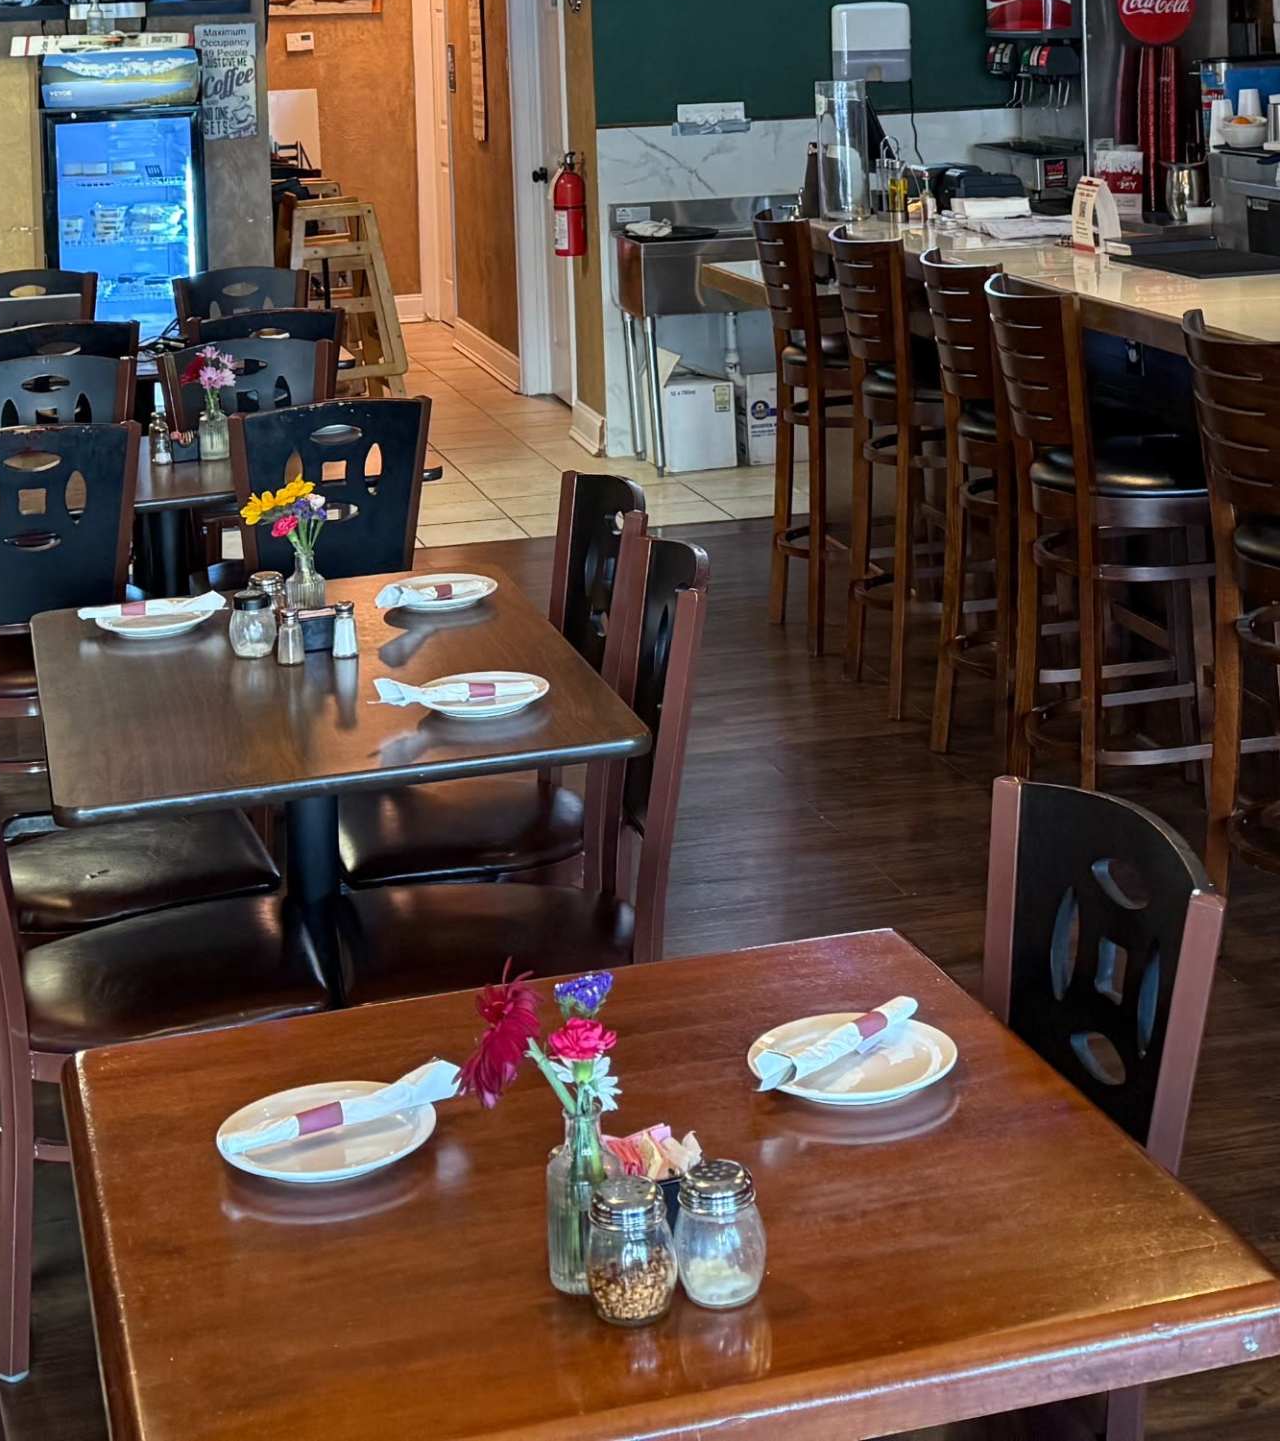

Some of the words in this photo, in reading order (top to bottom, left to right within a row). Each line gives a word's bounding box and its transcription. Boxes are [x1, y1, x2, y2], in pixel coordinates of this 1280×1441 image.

[202, 28, 247, 37] Maximum
[200, 38, 250, 48] Occupancy
[217, 48, 248, 57] People
[205, 58, 221, 68] JUST
[238, 57, 247, 67] ME
[204, 67, 255, 99] Coffee
